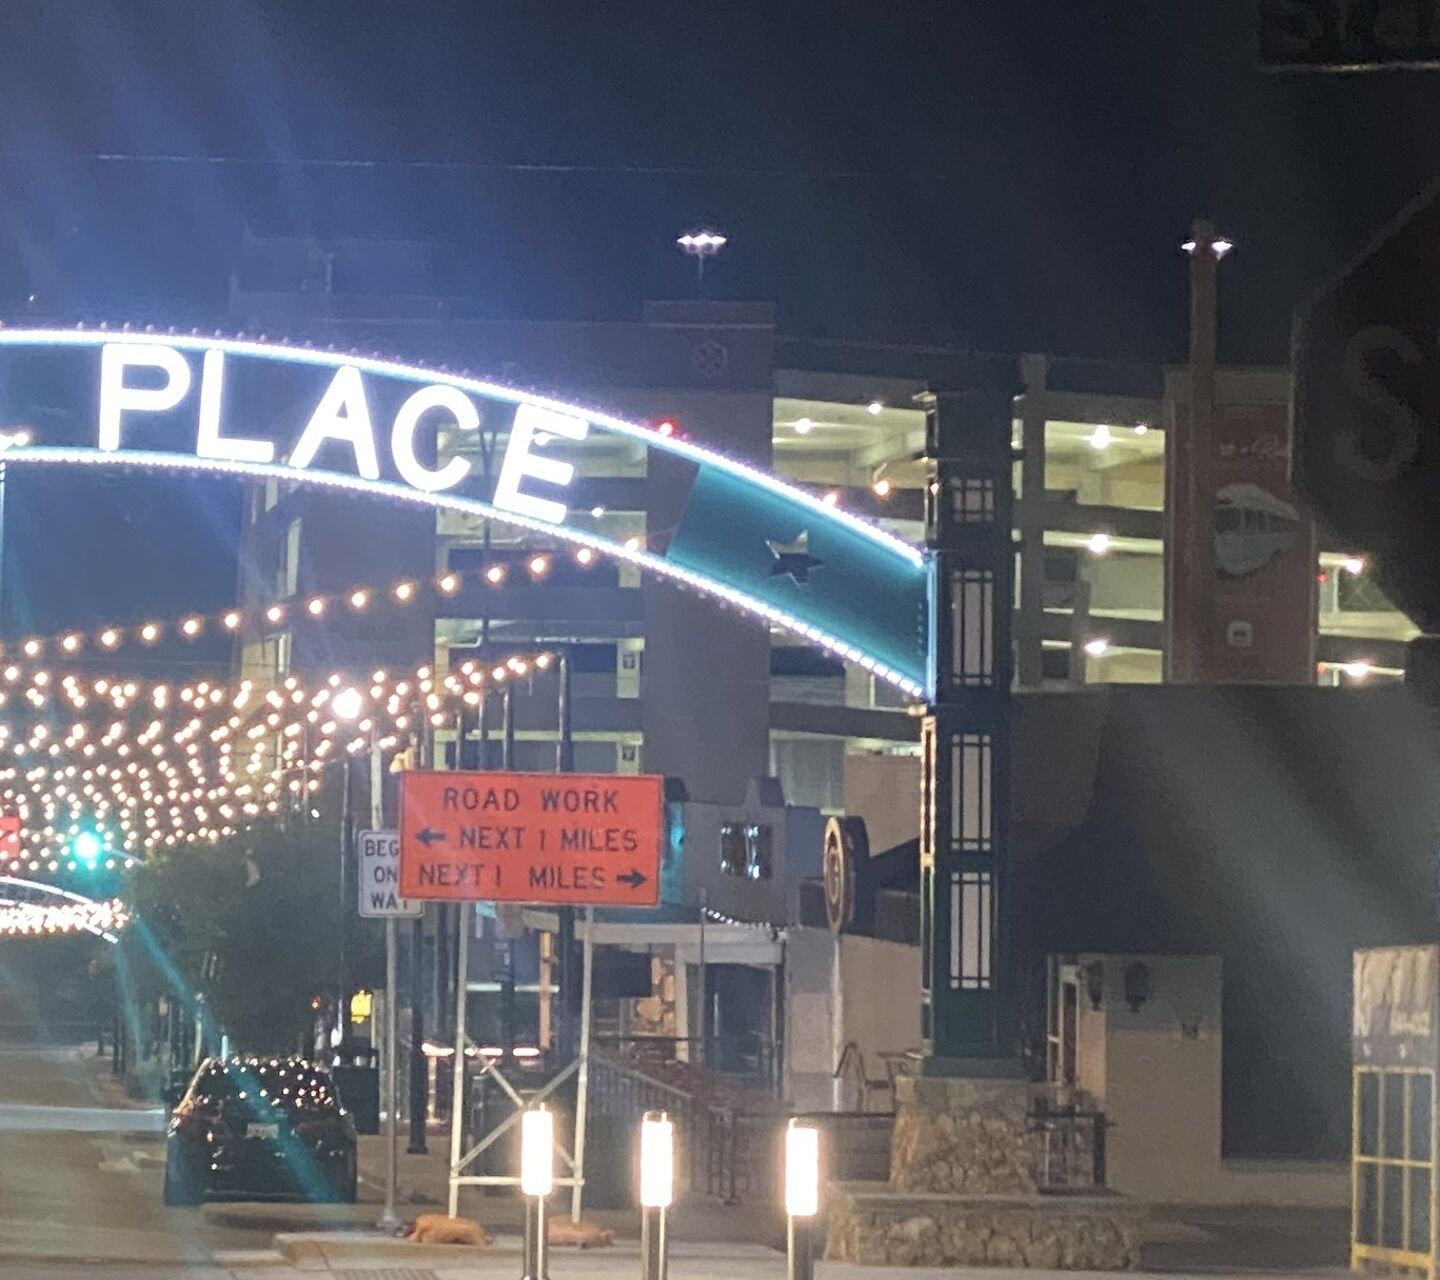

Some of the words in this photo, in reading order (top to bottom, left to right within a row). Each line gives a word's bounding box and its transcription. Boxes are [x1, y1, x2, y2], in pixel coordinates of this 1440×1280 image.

[98, 342, 590, 524] PLACE
[443, 787, 520, 812] ROAD
[541, 789, 619, 813] WORK
[460, 825, 526, 850] NEXT
[539, 829, 546, 851] 1
[561, 828, 638, 852] MILES
[419, 863, 485, 887] NEXT
[528, 866, 606, 890] MILES
